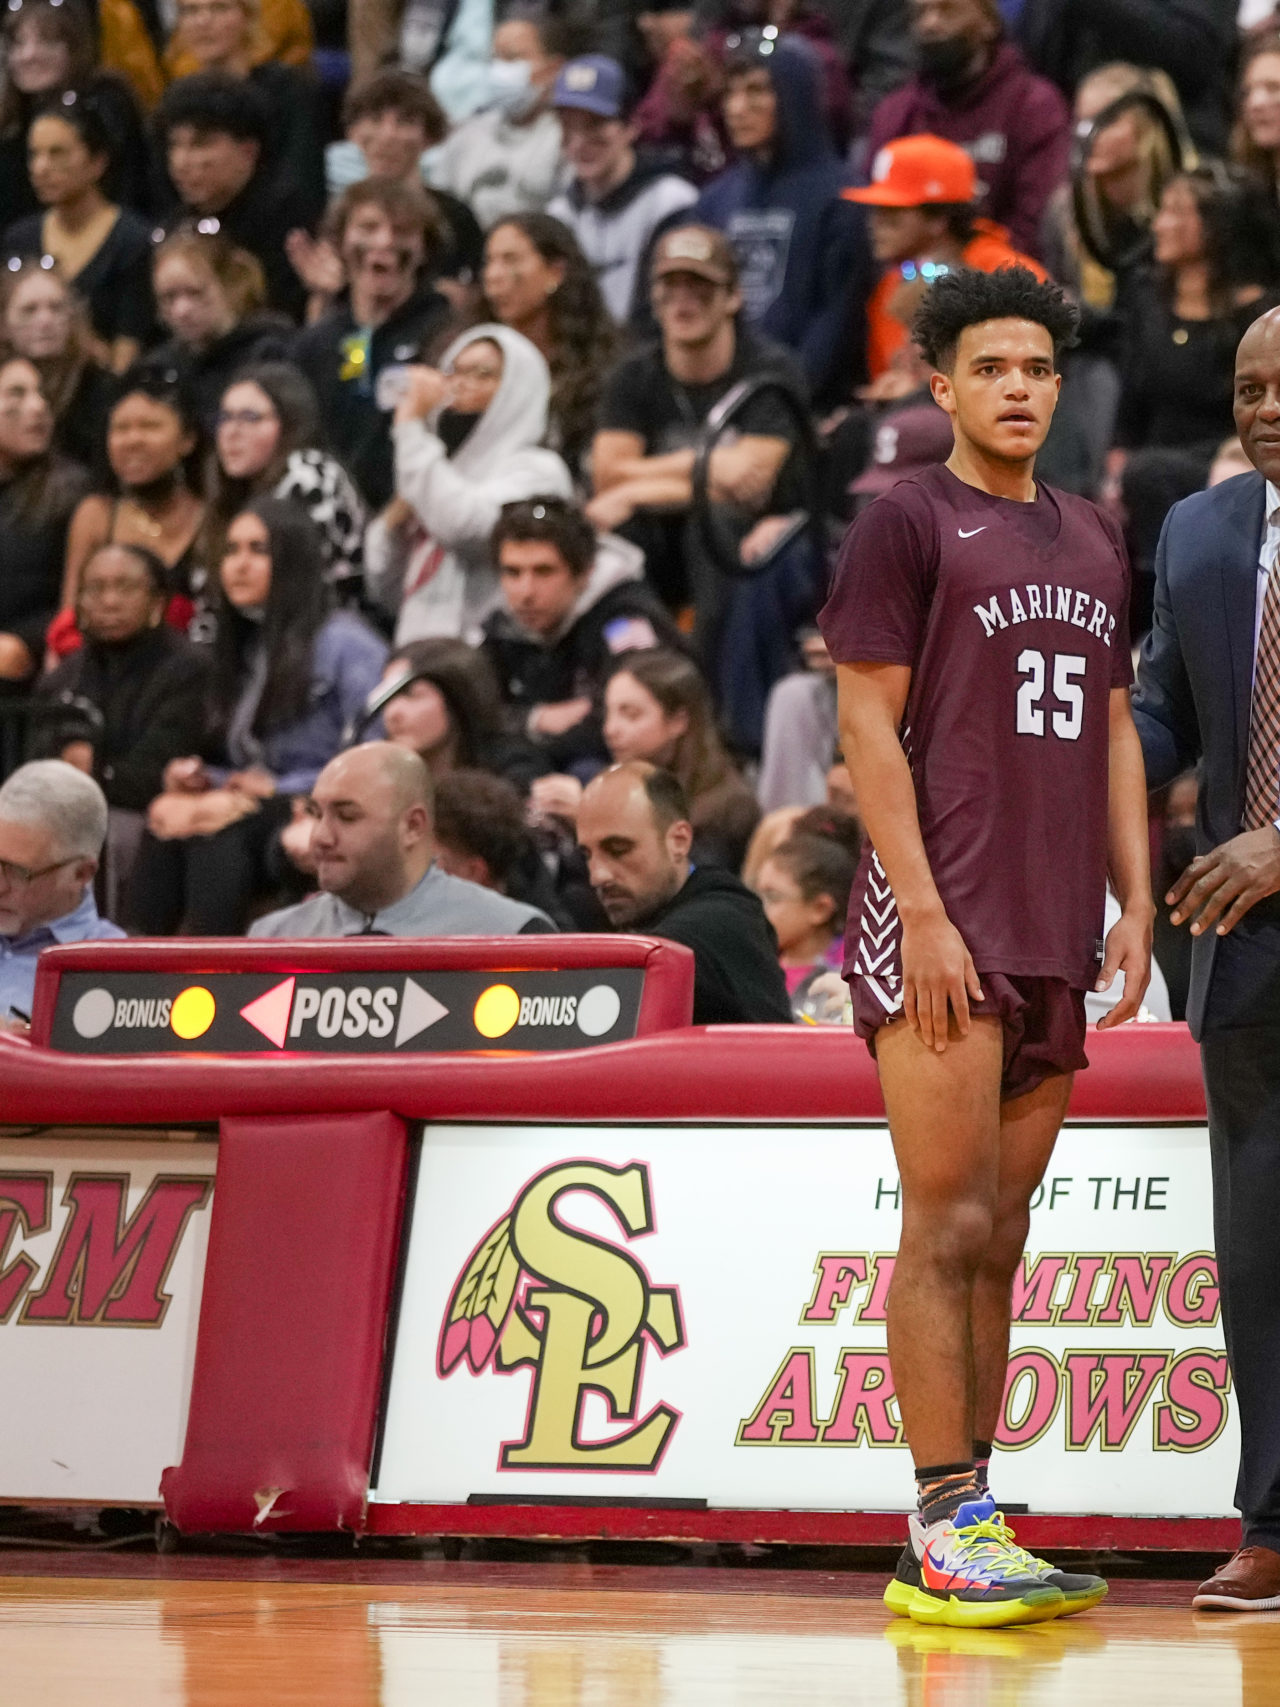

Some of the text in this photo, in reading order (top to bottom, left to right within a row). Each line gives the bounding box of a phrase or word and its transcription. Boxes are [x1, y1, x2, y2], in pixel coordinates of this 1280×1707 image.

[973, 584, 1116, 647] MARINERS
[1016, 649, 1087, 740] 25
[114, 986, 577, 1039] BONUS POSS BONUS
[1088, 1177, 1170, 1210] THE
[798, 1250, 1222, 1328] FLMING
[734, 1346, 1231, 1454] AROWS
